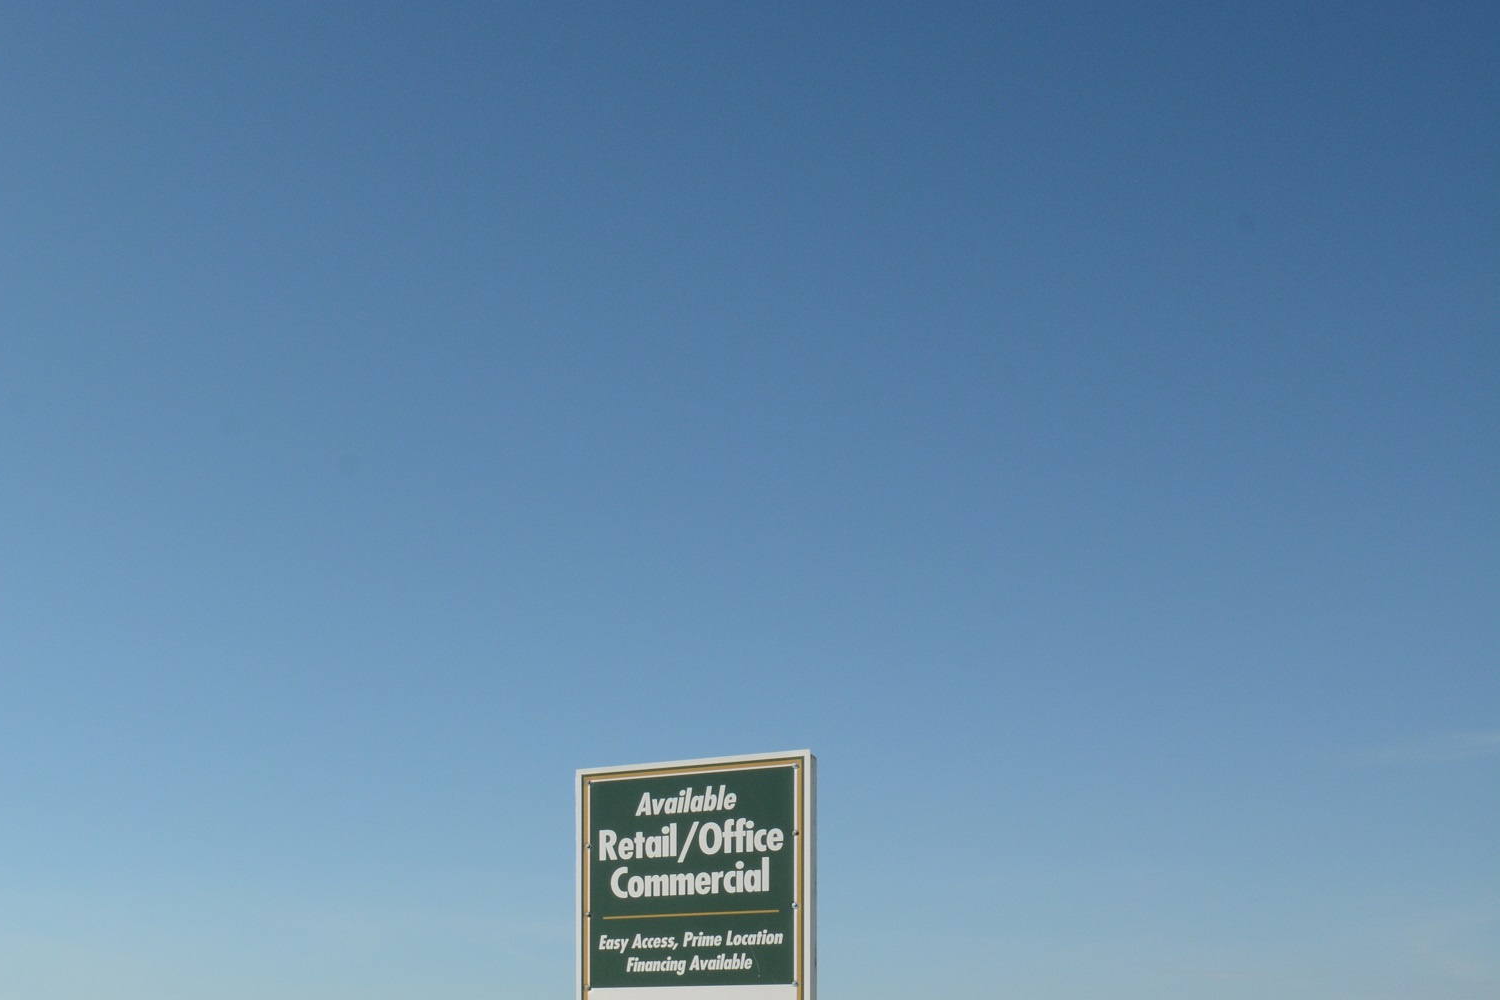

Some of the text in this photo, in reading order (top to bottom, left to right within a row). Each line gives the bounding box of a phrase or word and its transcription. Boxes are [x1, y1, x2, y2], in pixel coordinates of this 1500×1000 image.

[635, 785, 737, 816] Available
[599, 818, 784, 863] Retail/Office
[611, 857, 769, 898] Commercial
[599, 930, 783, 953] Easy Access, Prime Location
[626, 953, 752, 975] Financing Available
